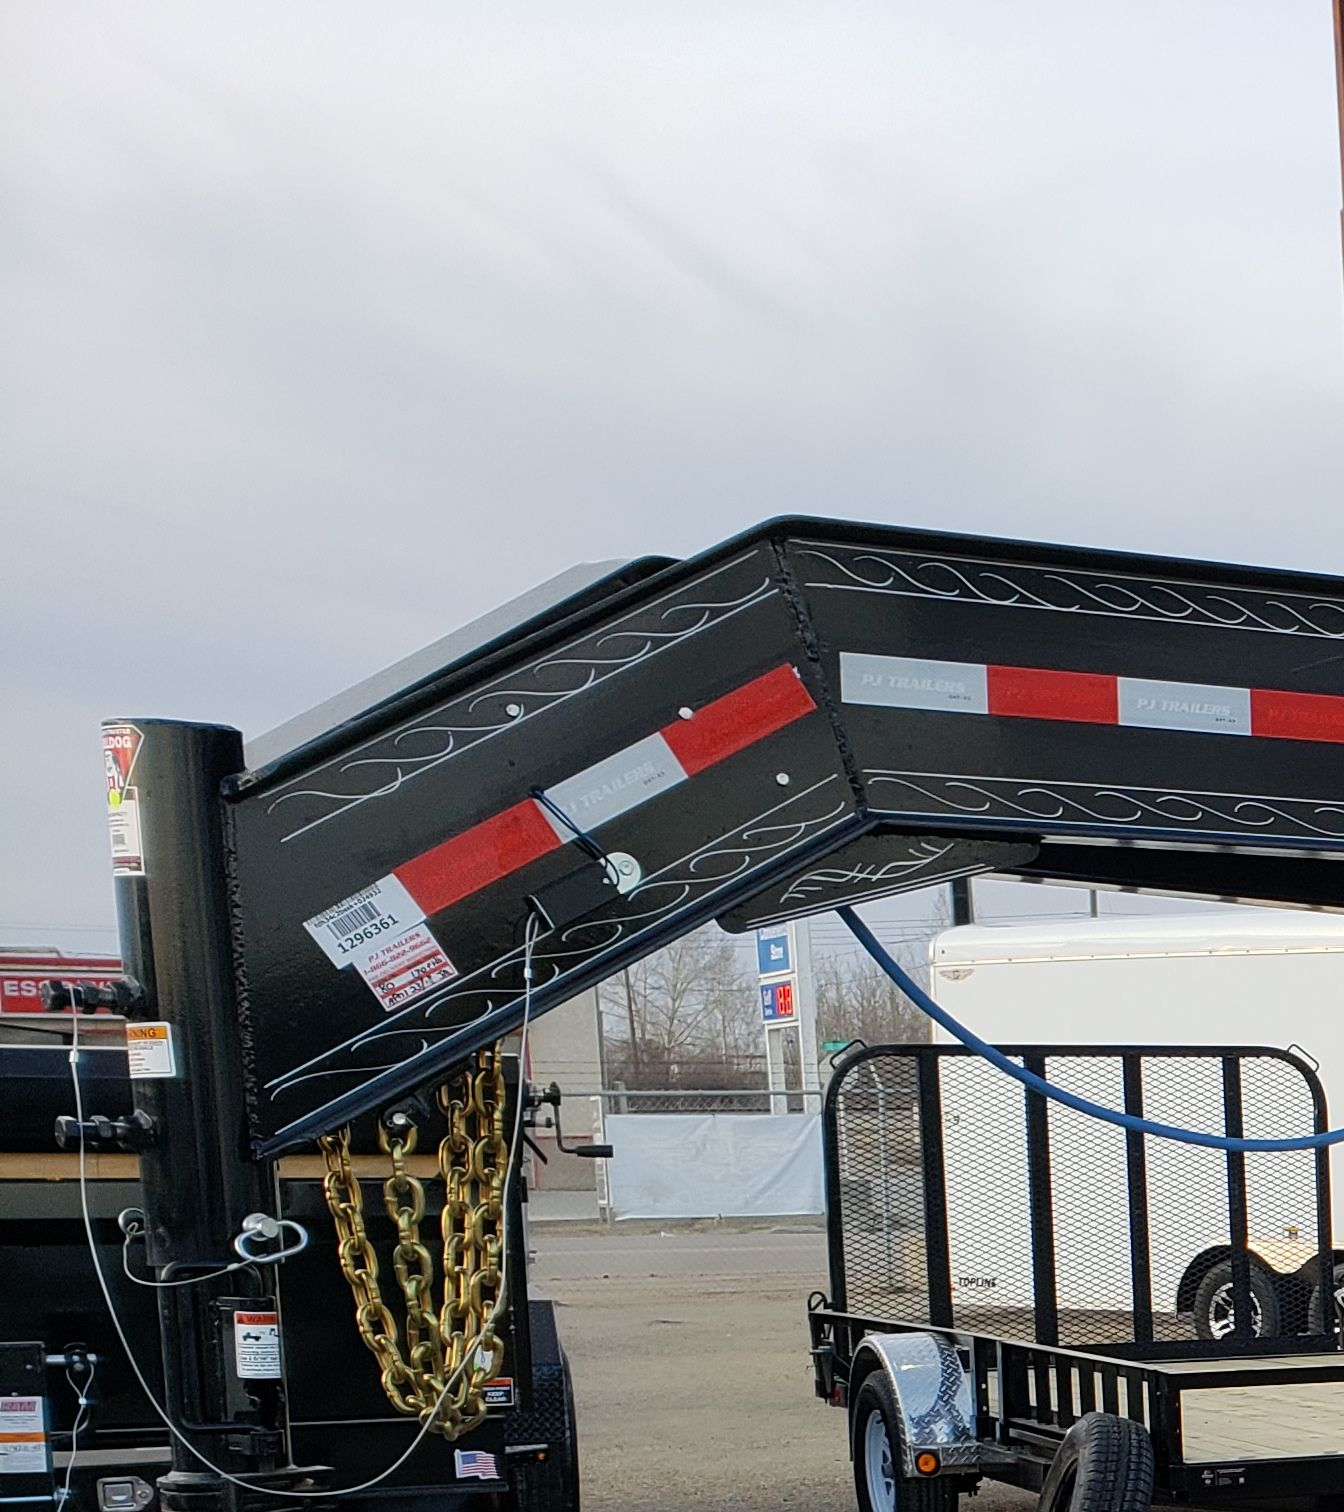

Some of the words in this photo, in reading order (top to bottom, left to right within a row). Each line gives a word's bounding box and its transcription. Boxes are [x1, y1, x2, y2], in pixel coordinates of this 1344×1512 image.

[861, 673, 883, 687] PJ
[887, 674, 966, 693] TRAILERS
[1137, 698, 1156, 710] PJ
[1161, 699, 1232, 717] TRAILERS
[580, 760, 656, 808] TRAILERS
[337, 913, 399, 955] 1296361
[381, 931, 421, 957] TRAILERS
